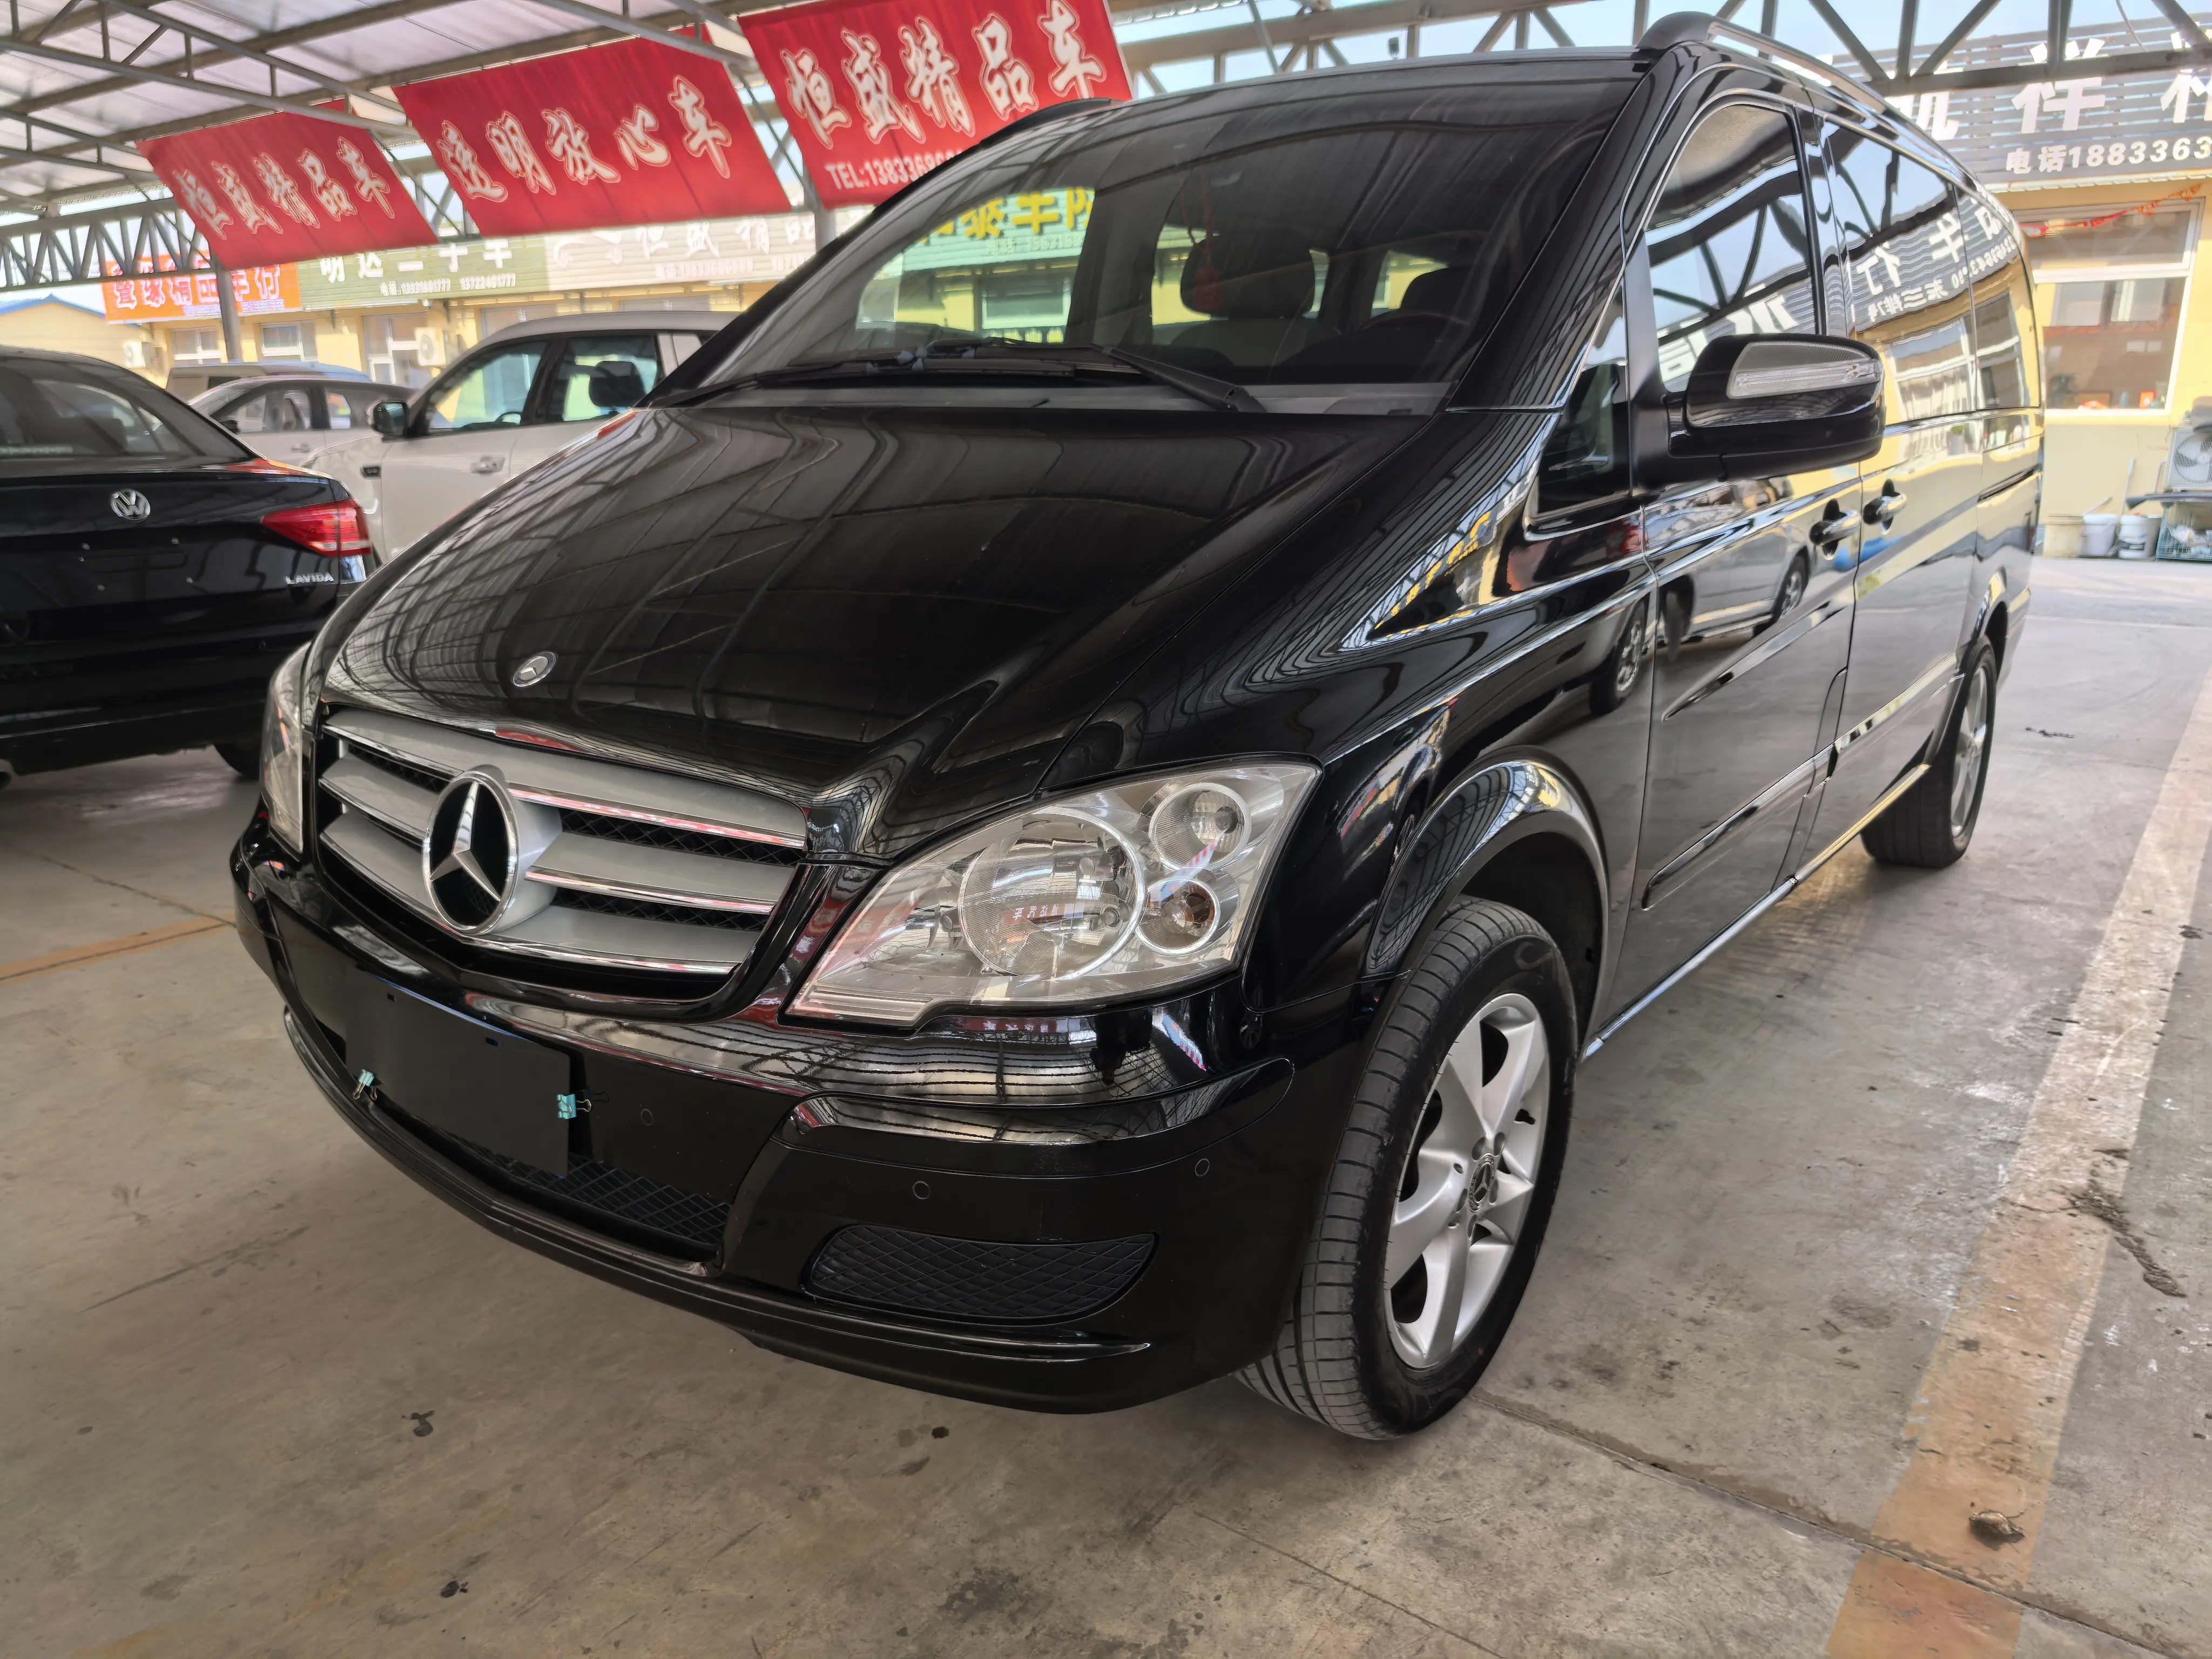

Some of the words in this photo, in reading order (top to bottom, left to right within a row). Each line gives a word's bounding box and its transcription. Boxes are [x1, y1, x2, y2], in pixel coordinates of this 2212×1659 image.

[780, 0, 1106, 149] 恒盛精品车
[172, 137, 394, 240] 恒盛精品车
[285, 572, 334, 584] LAVIDA
